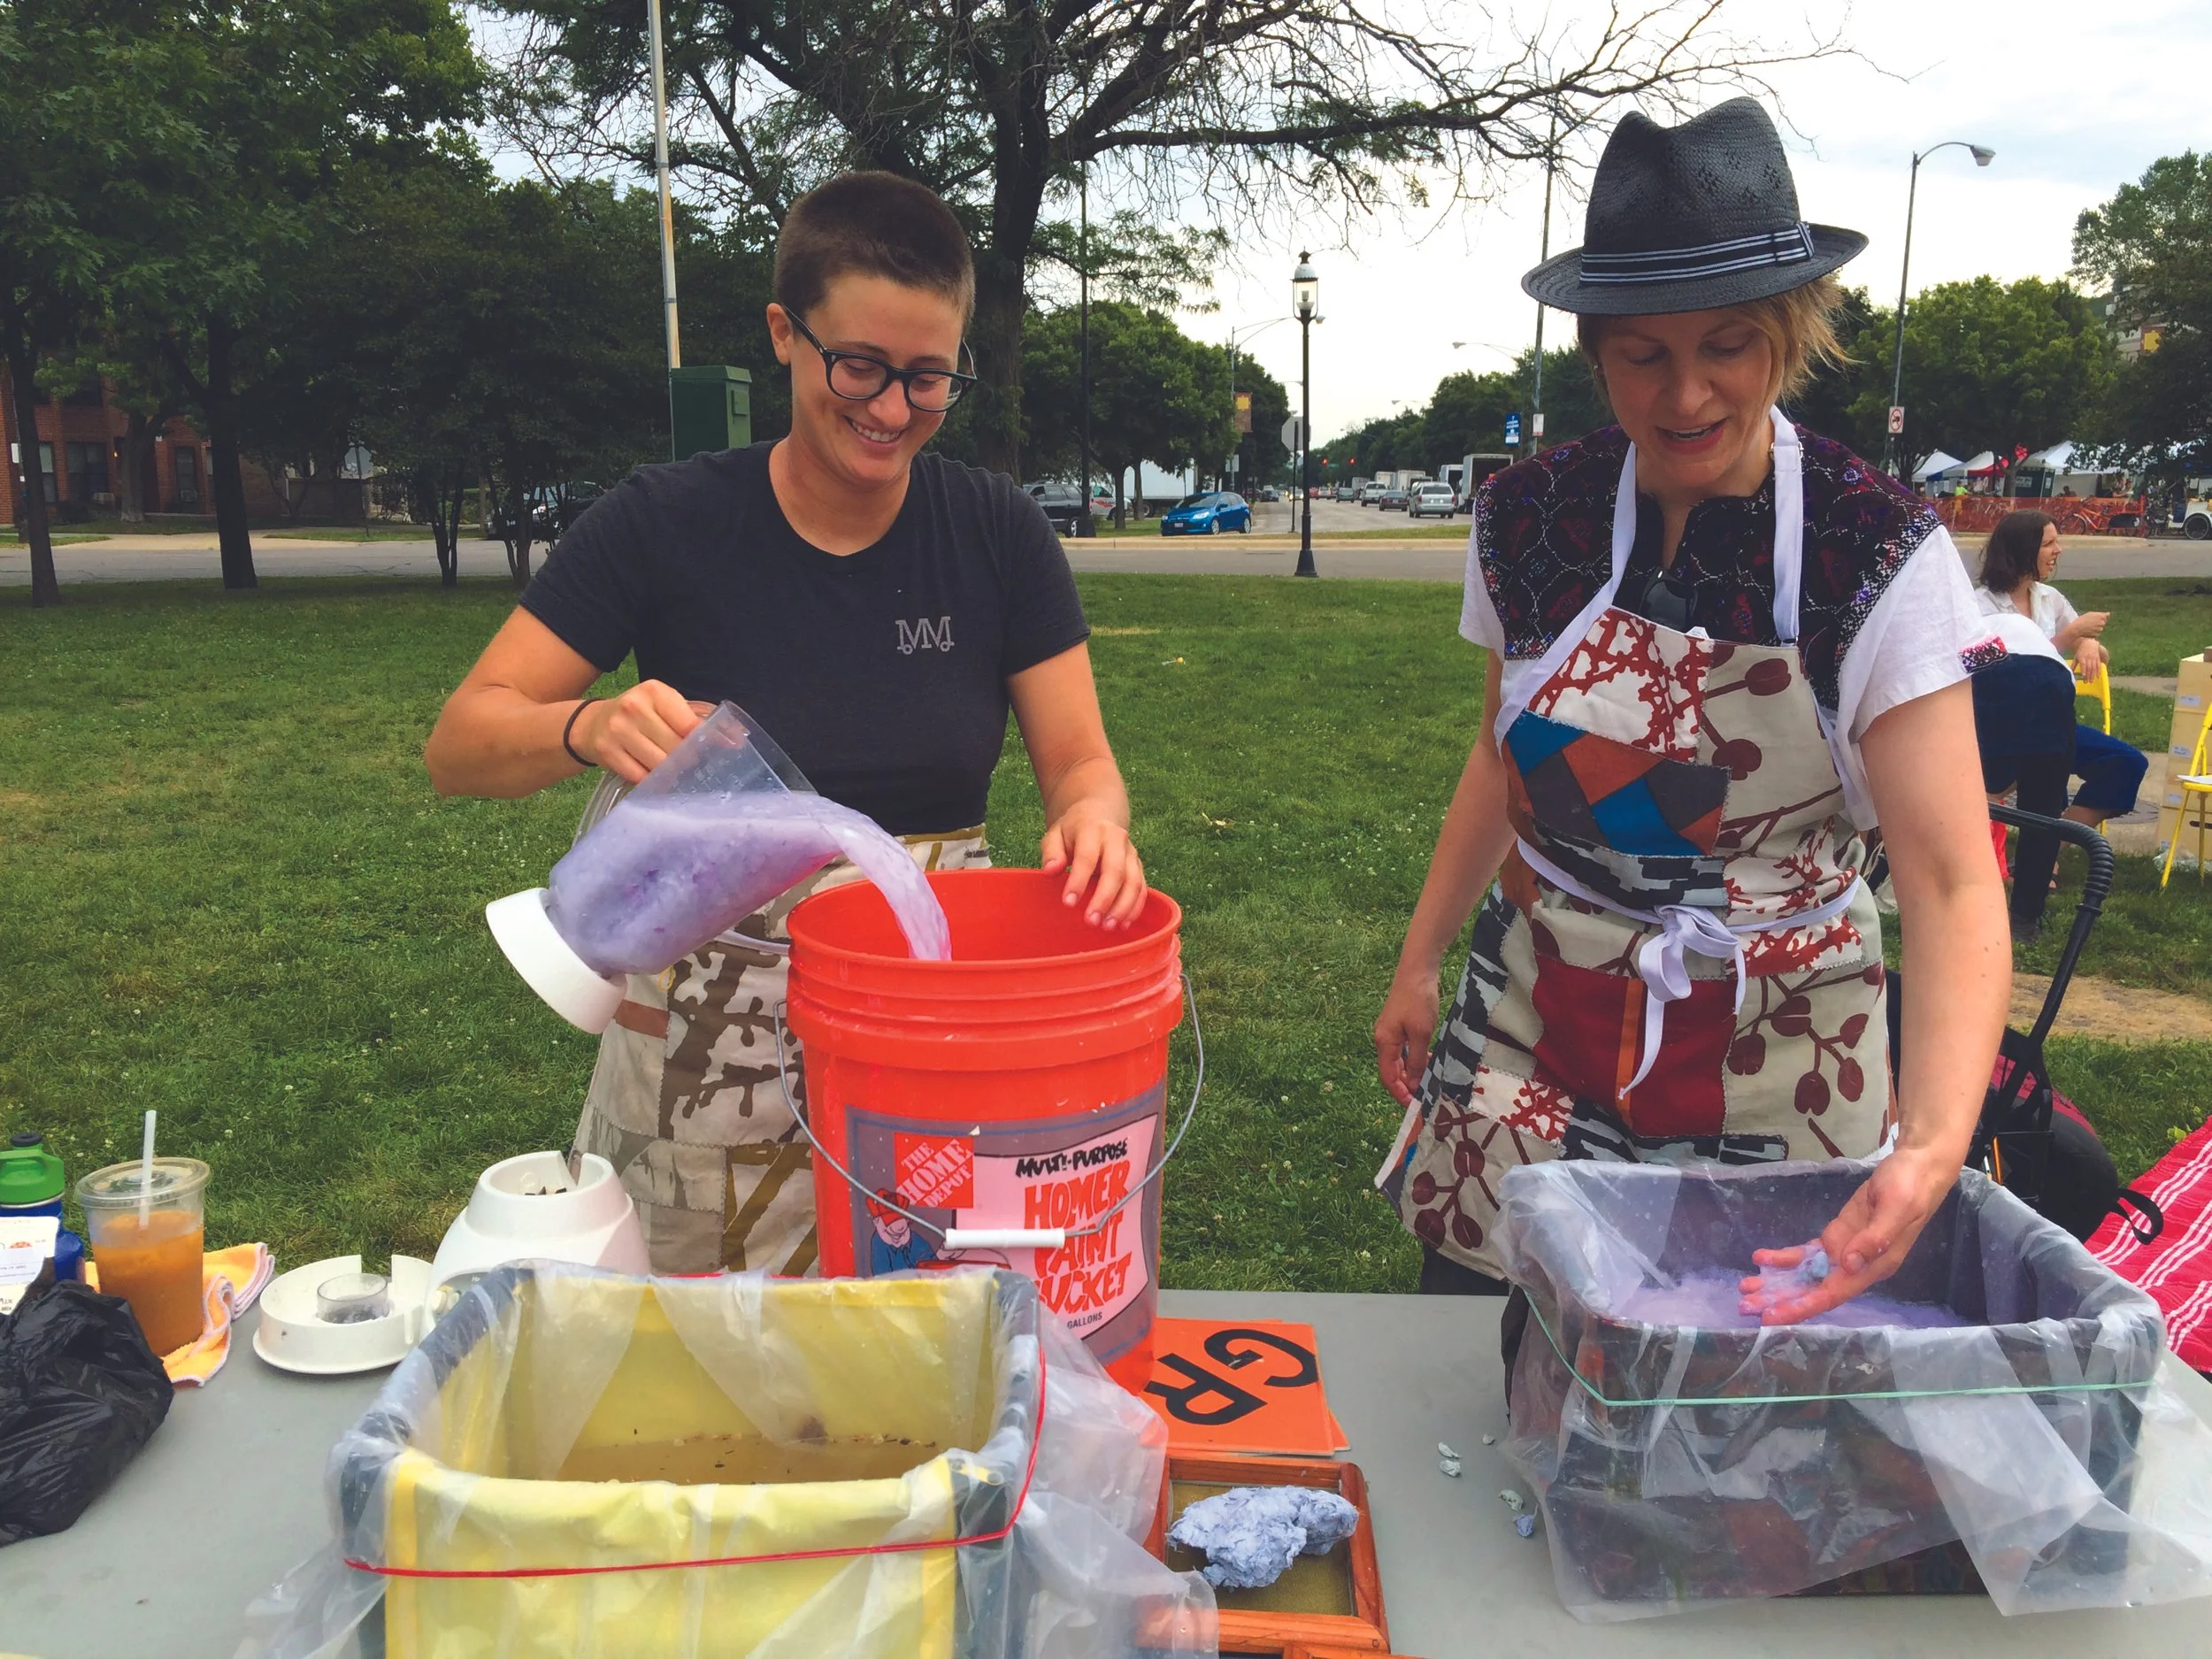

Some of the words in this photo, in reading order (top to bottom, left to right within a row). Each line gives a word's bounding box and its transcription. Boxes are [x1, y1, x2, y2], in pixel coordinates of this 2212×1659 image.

[896, 1139, 973, 1205] HOME
[901, 1141, 935, 1172] THE
[923, 1164, 972, 1208] DEPOT
[1024, 1160, 1130, 1230] HOMER
[1034, 1251, 1133, 1314] UCKET
[1067, 1311, 1102, 1329] GALLONS
